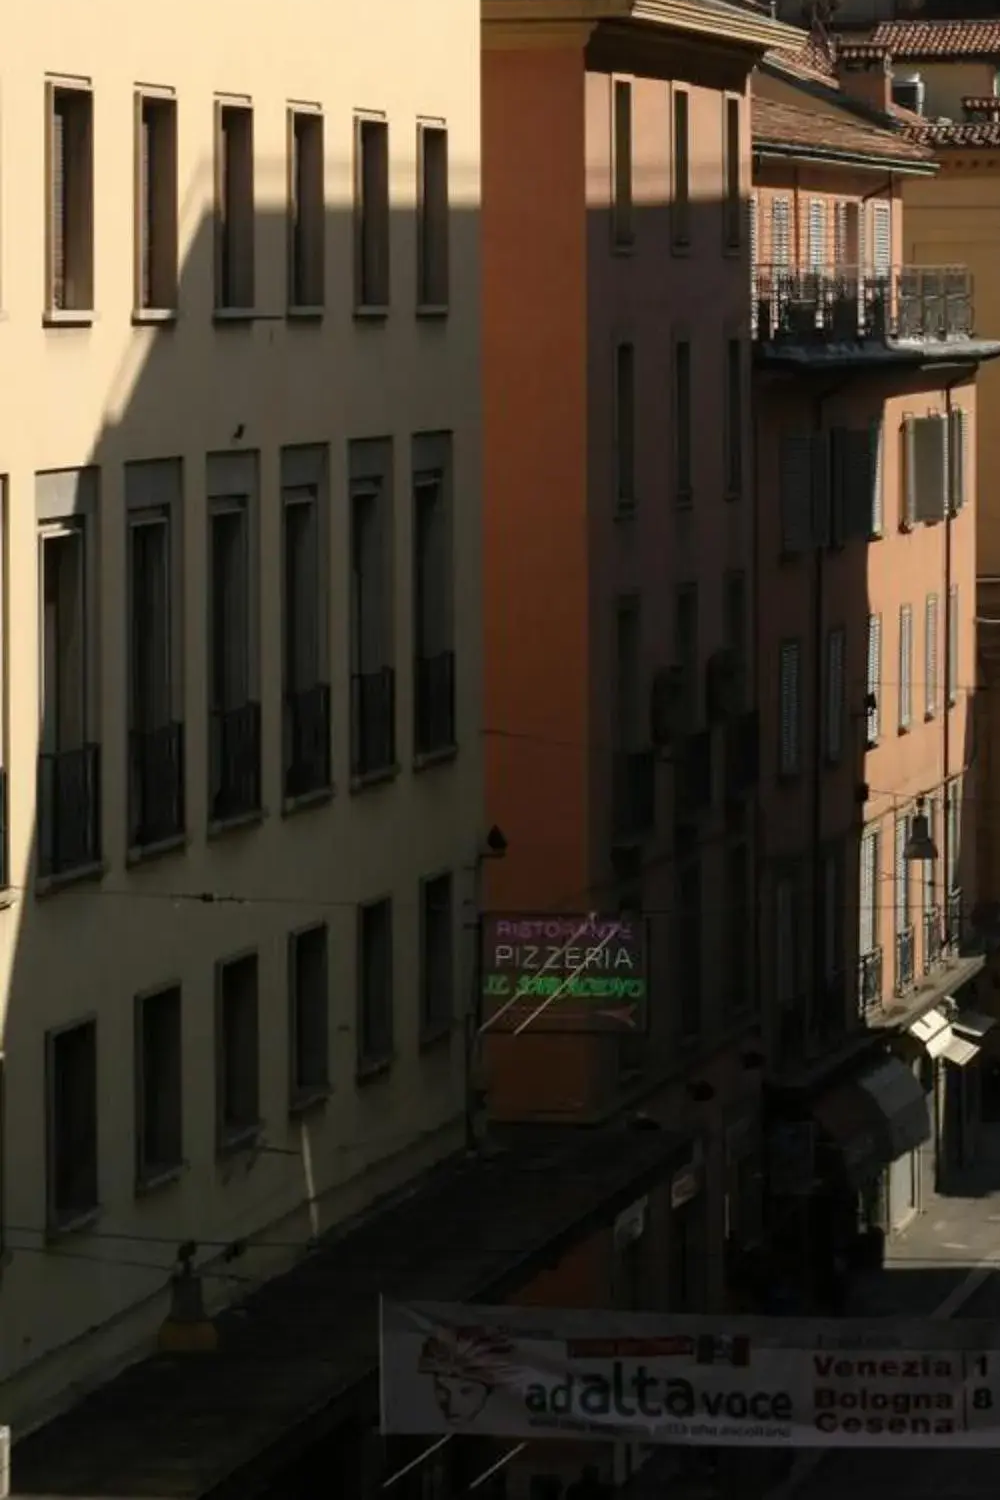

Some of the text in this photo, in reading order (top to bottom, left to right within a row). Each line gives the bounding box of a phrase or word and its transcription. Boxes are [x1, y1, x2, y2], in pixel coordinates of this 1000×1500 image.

[496, 920, 634, 940] RISTORANTE
[495, 945, 634, 970] PIZZERIA
[813, 1355, 952, 1377] Venezia
[974, 1355, 988, 1377] 1
[814, 1386, 953, 1414] Bologna
[972, 1387, 993, 1410] 8
[815, 1411, 954, 1434] Cesena
